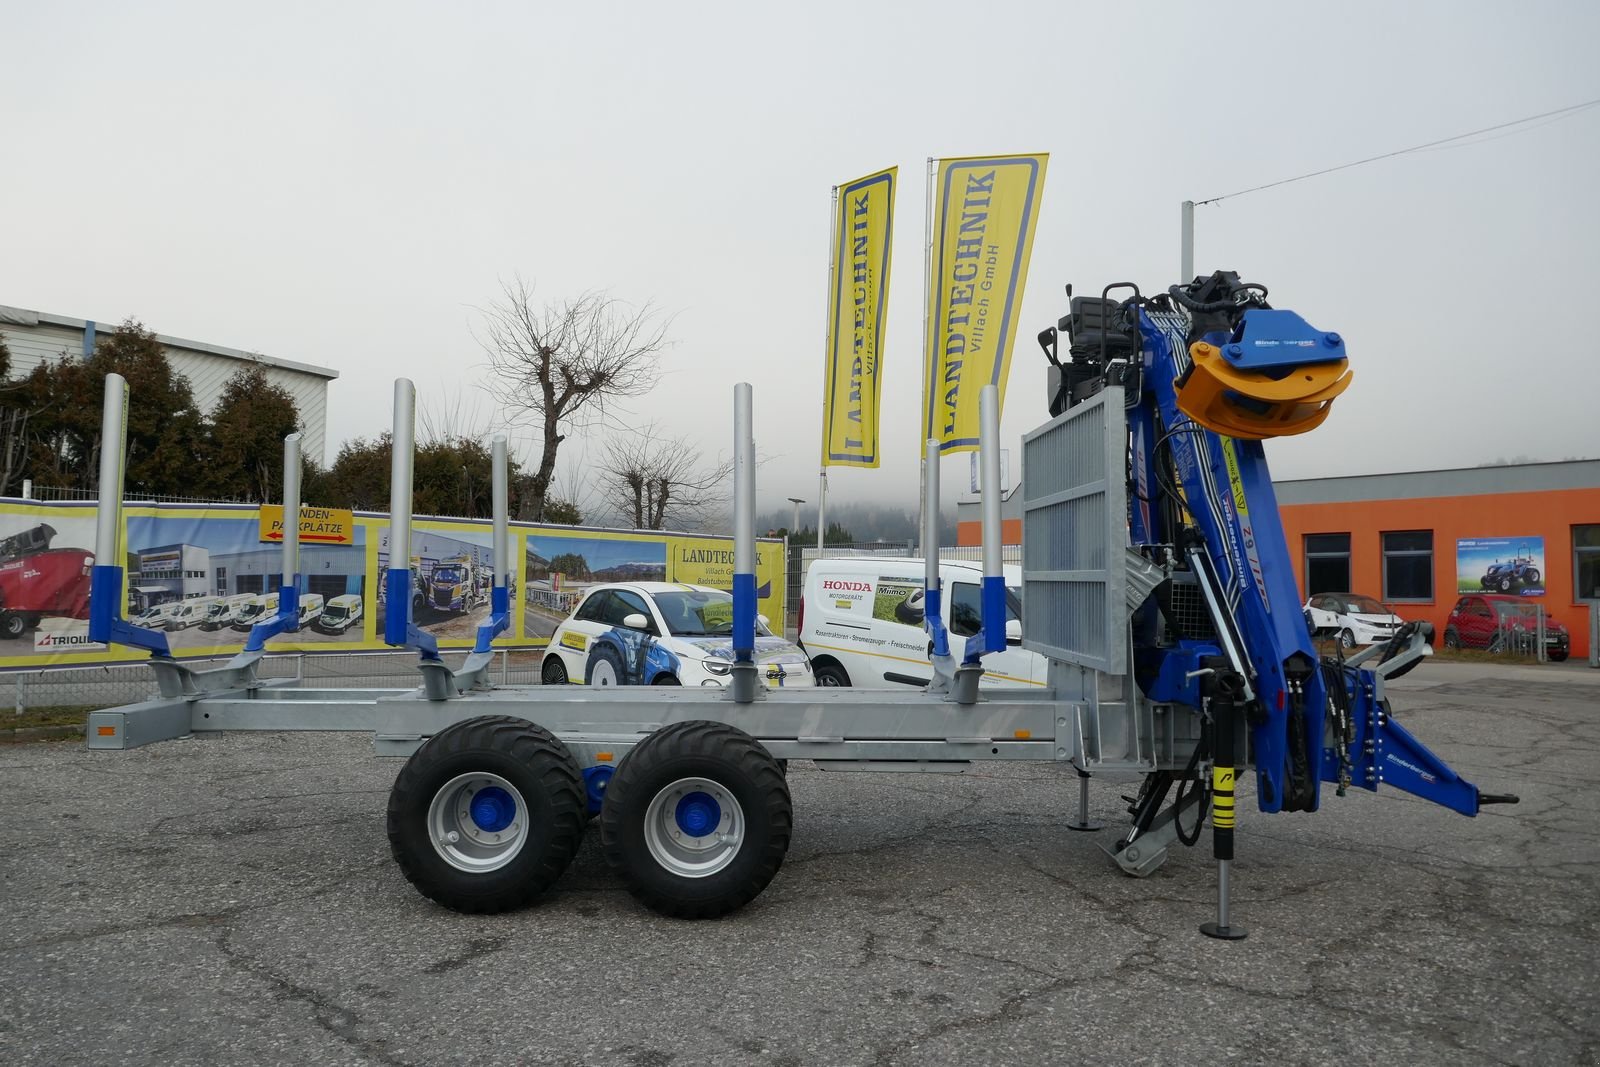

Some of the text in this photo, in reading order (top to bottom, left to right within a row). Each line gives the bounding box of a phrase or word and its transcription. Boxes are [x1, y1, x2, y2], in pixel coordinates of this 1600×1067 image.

[944, 170, 996, 437] LANDTECHNIK
[970, 245, 999, 352] Villach GmbH
[300, 509, 335, 520] NDEN-
[272, 520, 343, 534] PAKPLÄTZE
[1222, 499, 1248, 589] Binderberger
[682, 549, 763, 565] LANDTECK
[823, 580, 872, 593] HONDA
[829, 593, 863, 601] MOTORGERÄTE
[815, 629, 925, 652] Rasentraktoren Stromerzeuger Freischneider
